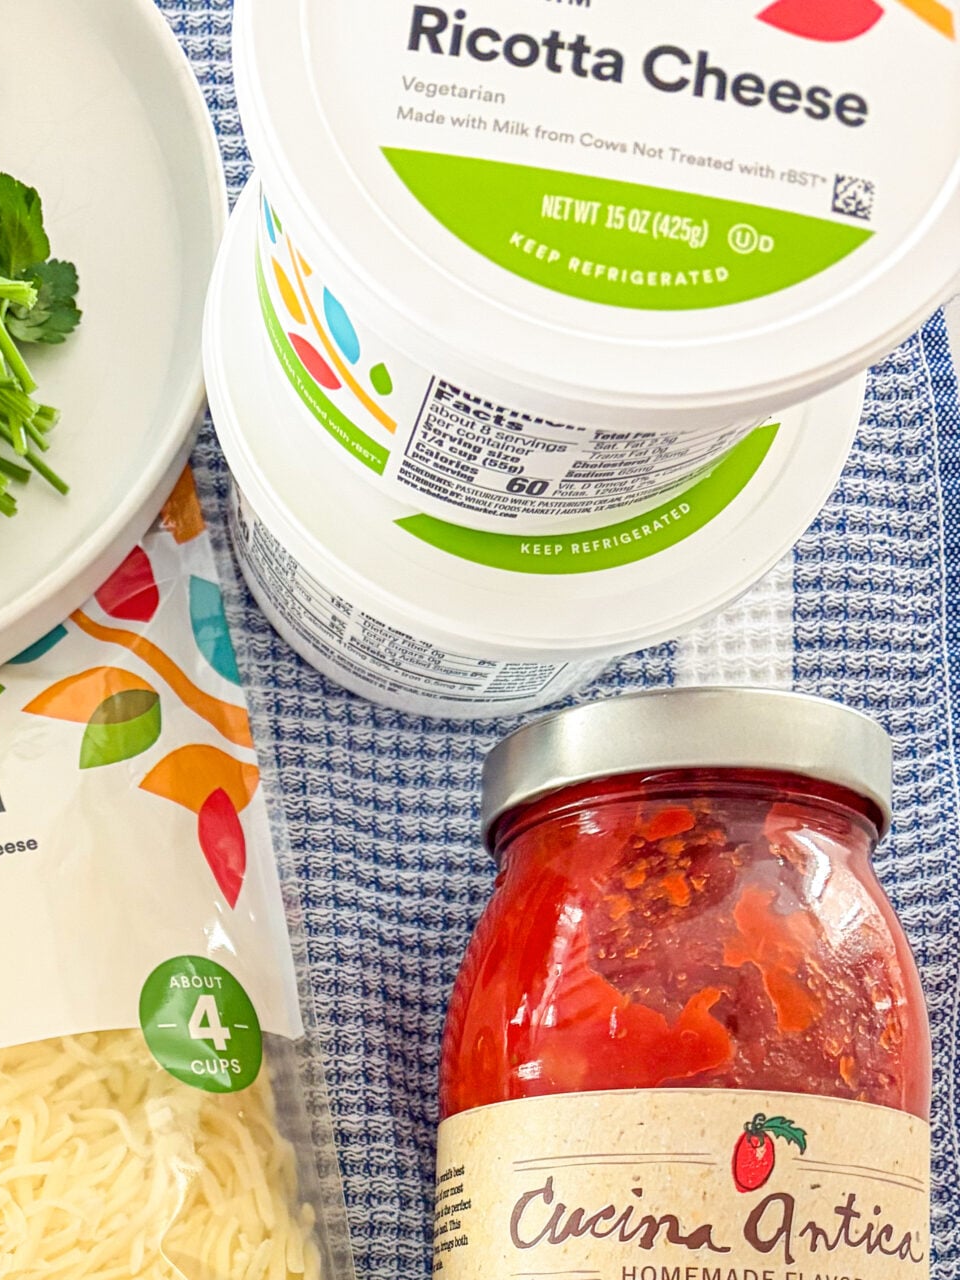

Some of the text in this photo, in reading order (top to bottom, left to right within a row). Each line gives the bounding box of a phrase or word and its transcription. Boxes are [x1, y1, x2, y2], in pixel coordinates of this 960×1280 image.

[406, 5, 870, 127] Ricotta Cheese
[401, 75, 506, 107] Vegetarian
[396, 105, 446, 125] Made
[451, 113, 488, 132] with
[492, 119, 530, 138] Milk
[535, 125, 575, 145] from
[579, 133, 628, 153] Cows
[633, 142, 664, 160] Not
[669, 147, 734, 171] Treated
[738, 162, 775, 179] with
[541, 194, 709, 249] NET WT 15 OZ (425g)
[510, 232, 729, 288] KEEP REFRIGERATED
[430, 403, 476, 430] about
[495, 431, 568, 452] servings
[435, 389, 524, 431] Facts
[420, 431, 525, 475] 1/4 cup (55g)
[422, 422, 521, 463] Serving size
[425, 413, 534, 457] per container
[411, 451, 550, 496] per serving 60
[415, 442, 479, 475] Calories
[399, 468, 448, 495] DISTRIBUTED
[455, 484, 510, 503] PASTEURIZED
[520, 502, 692, 557] KEEP REFRIGERATED
[169, 975, 223, 990] ABOUT
[187, 994, 232, 1051] 4
[190, 1058, 242, 1077] CUPS
[510, 1175, 925, 1264] Cucina Antica
